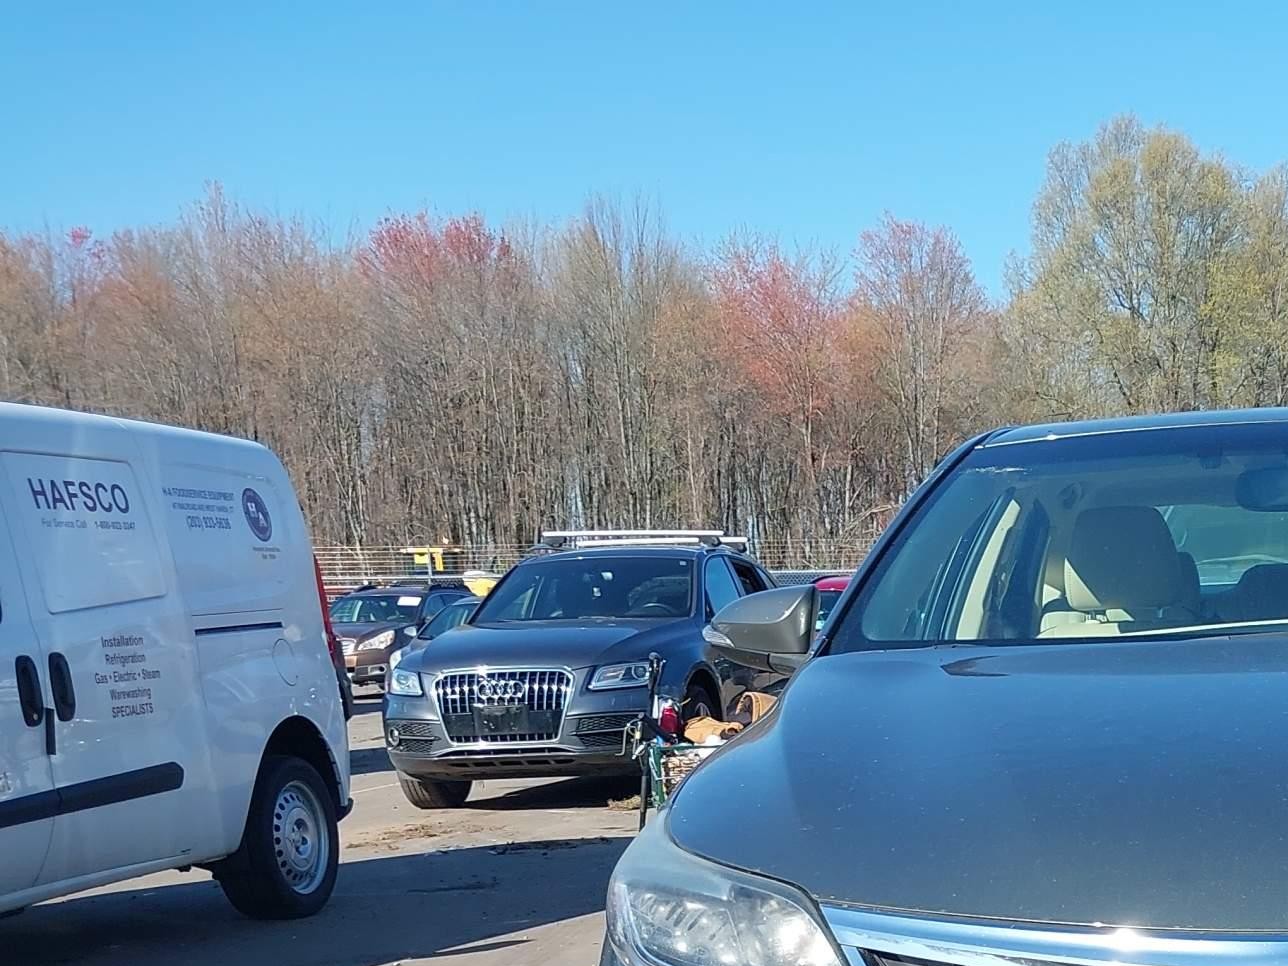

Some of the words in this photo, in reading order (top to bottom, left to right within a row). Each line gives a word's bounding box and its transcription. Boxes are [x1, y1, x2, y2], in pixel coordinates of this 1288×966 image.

[27, 478, 129, 513] HAFSCO
[101, 635, 144, 648] Installation
[105, 653, 146, 667] Refrigeration
[95, 672, 108, 684] Gas
[113, 671, 137, 682] Electric
[142, 668, 160, 680] Steam
[109, 688, 151, 700] Warewashing
[112, 703, 153, 718] SPECIALISTS
